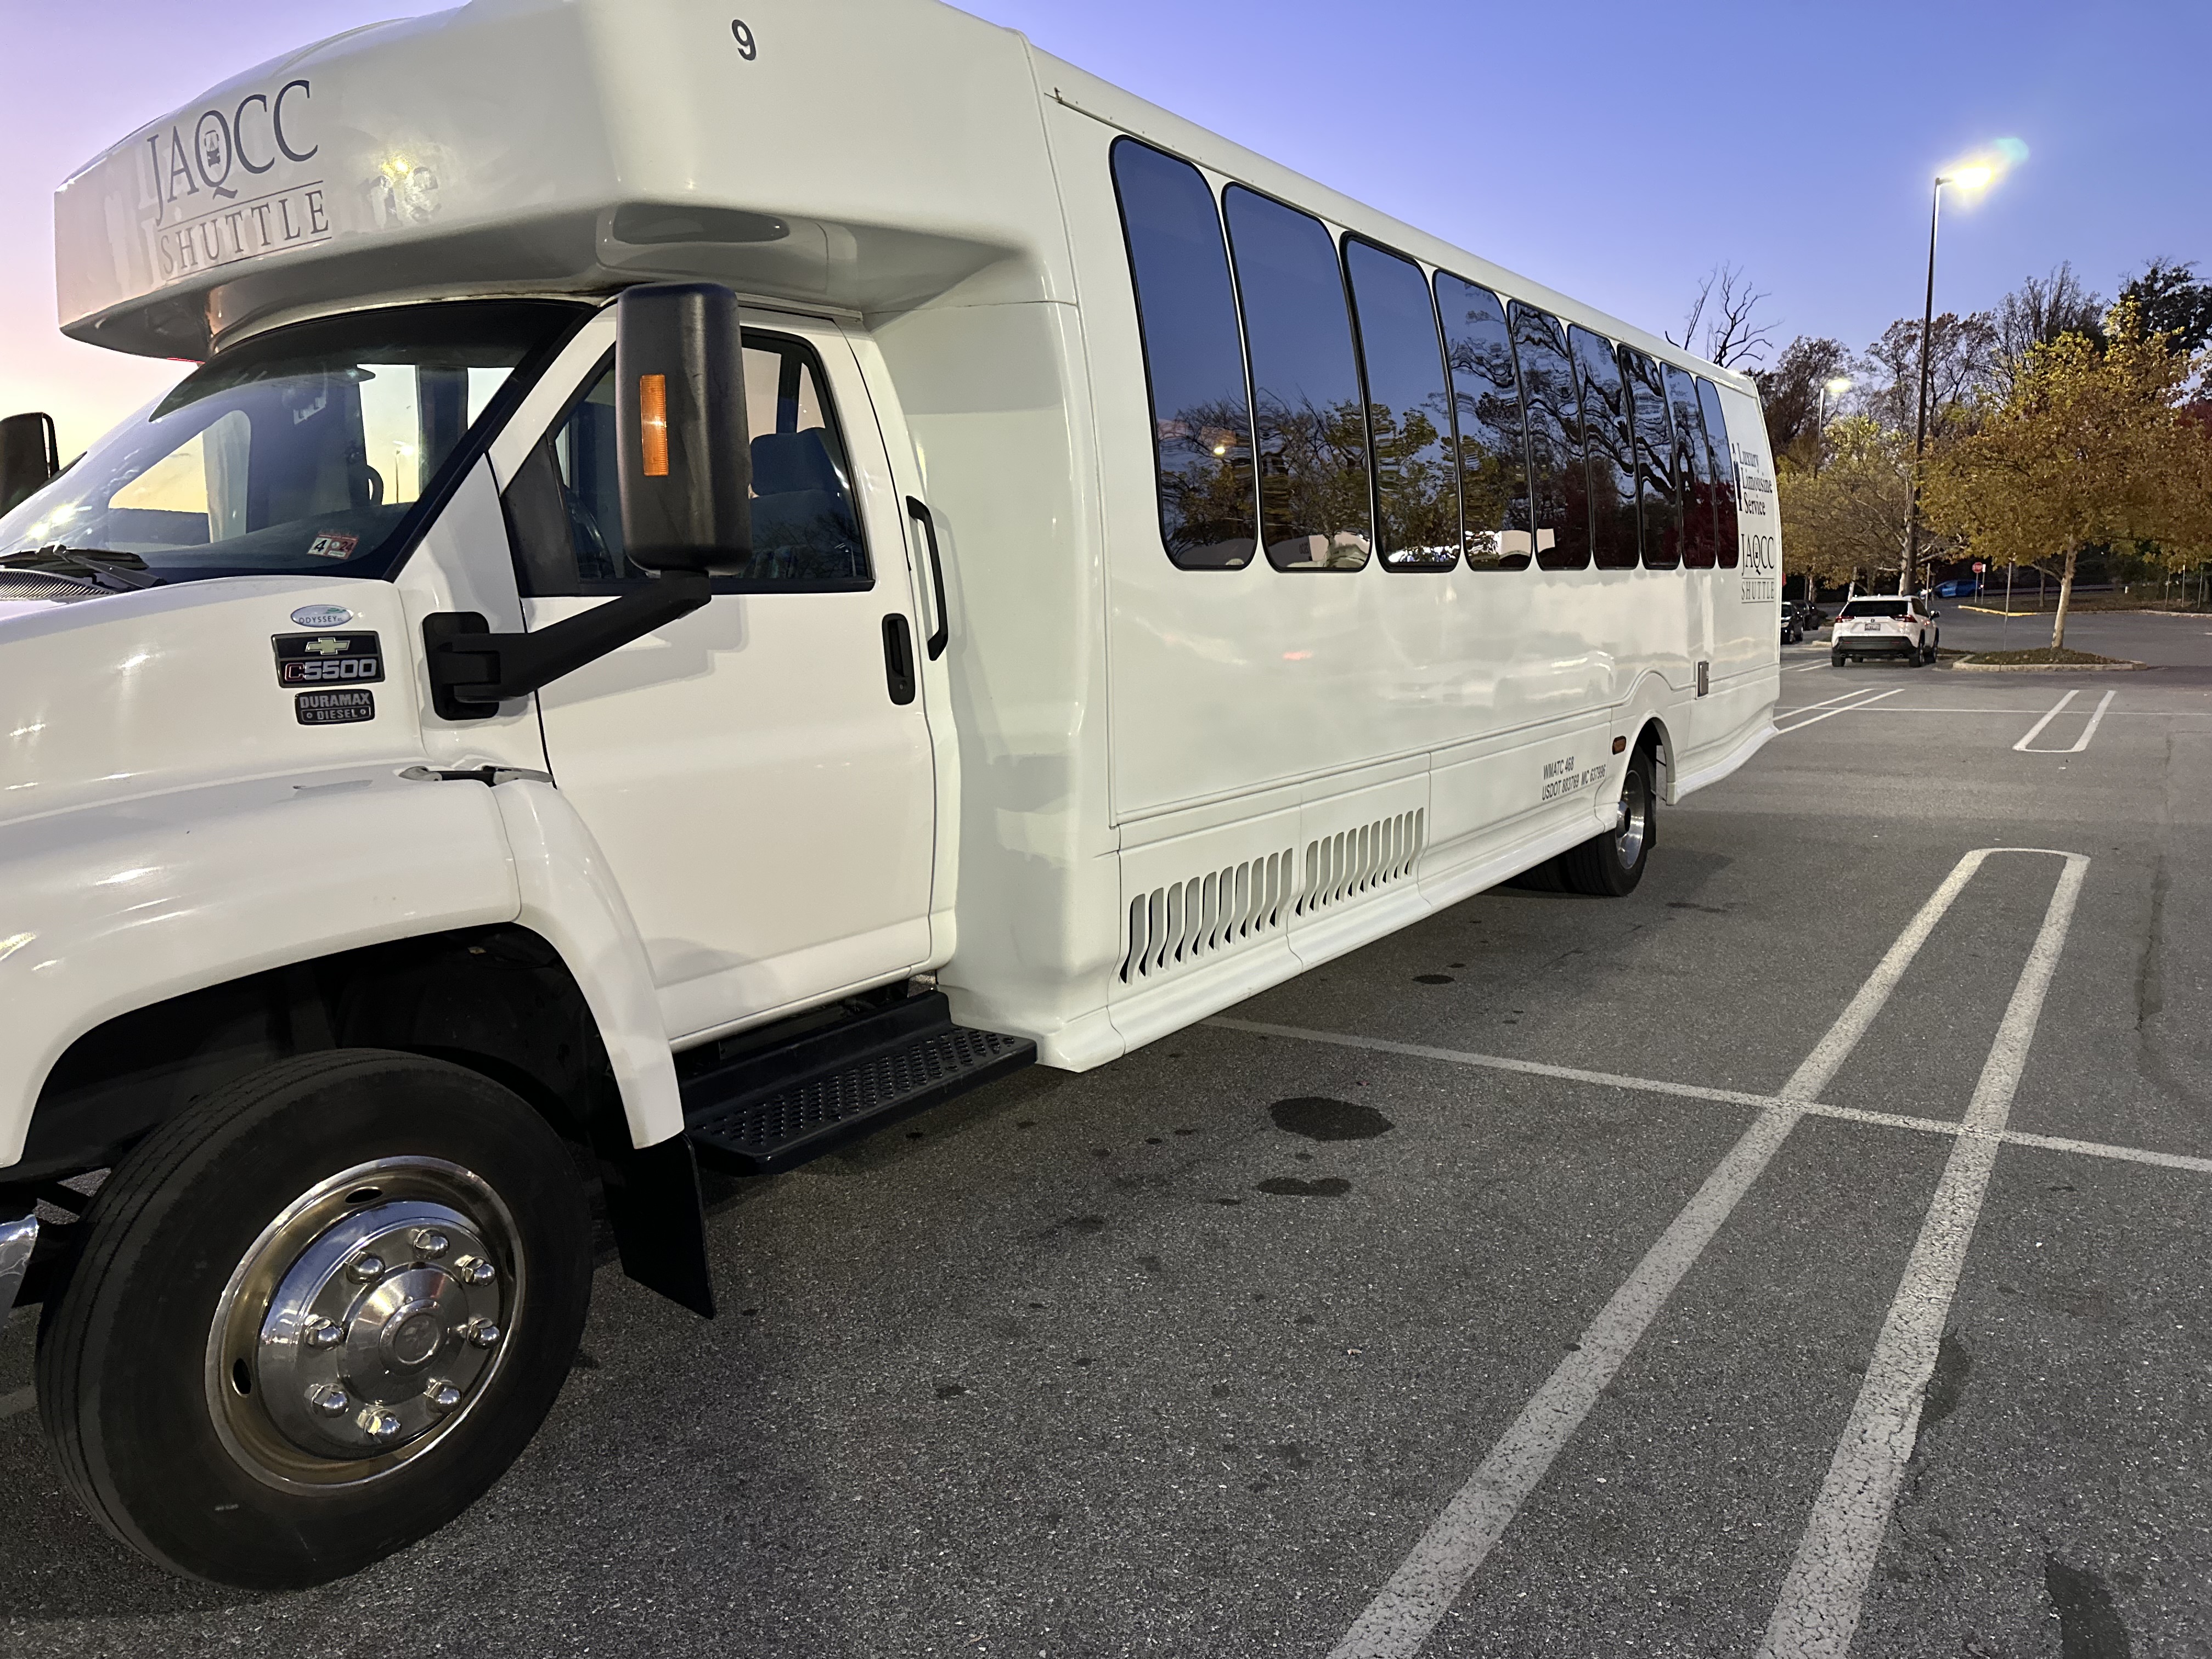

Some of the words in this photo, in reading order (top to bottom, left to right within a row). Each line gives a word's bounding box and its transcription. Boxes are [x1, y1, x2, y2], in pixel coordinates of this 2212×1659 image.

[732, 19, 757, 61] 9
[147, 80, 318, 227] JAQCC
[160, 190, 329, 275] SHUTTLE
[1737, 443, 1759, 473] Luxury
[1741, 467, 1773, 493] Limousine
[1744, 492, 1766, 516] Service
[314, 539, 328, 552] 4
[1741, 533, 1775, 577] JAQCC
[1741, 581, 1774, 600] SHUTTLE
[298, 616, 337, 624] ODYSSEY
[285, 659, 377, 681] C5500
[300, 693, 370, 708] DURAMAX
[317, 709, 358, 720] DIESEL
[1544, 759, 1564, 780] WMATC
[1565, 756, 1574, 771] 468
[1542, 780, 1561, 800] USDOT
[1581, 770, 1589, 785] MC
